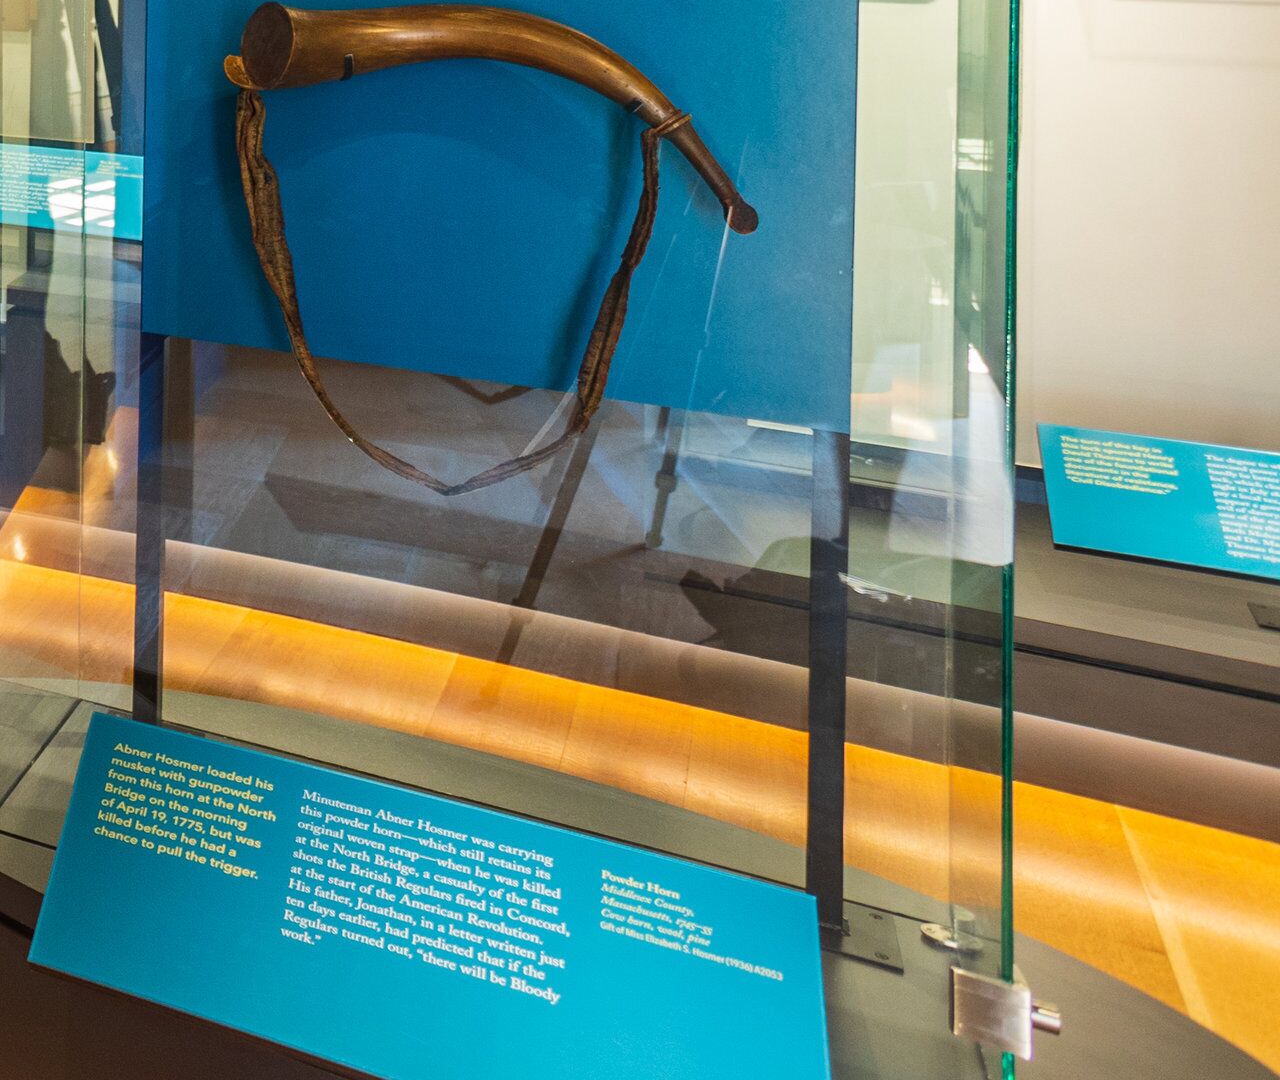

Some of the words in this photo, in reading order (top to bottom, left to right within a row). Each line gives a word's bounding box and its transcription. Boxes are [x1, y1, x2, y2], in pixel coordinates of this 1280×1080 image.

[111, 757, 156, 775] musket
[158, 769, 185, 782] with
[188, 777, 263, 802] gunpowder
[113, 743, 152, 759] Abner
[155, 752, 204, 772] Hosmer
[206, 765, 252, 785] loaded
[254, 777, 273, 791] his
[302, 789, 371, 816] Minuteman
[375, 809, 413, 826] Abner
[417, 819, 467, 841] Hosmer
[470, 836, 494, 848] was
[498, 844, 553, 867] carrying
[601, 869, 644, 889] Powder
[647, 882, 679, 899] Horn
